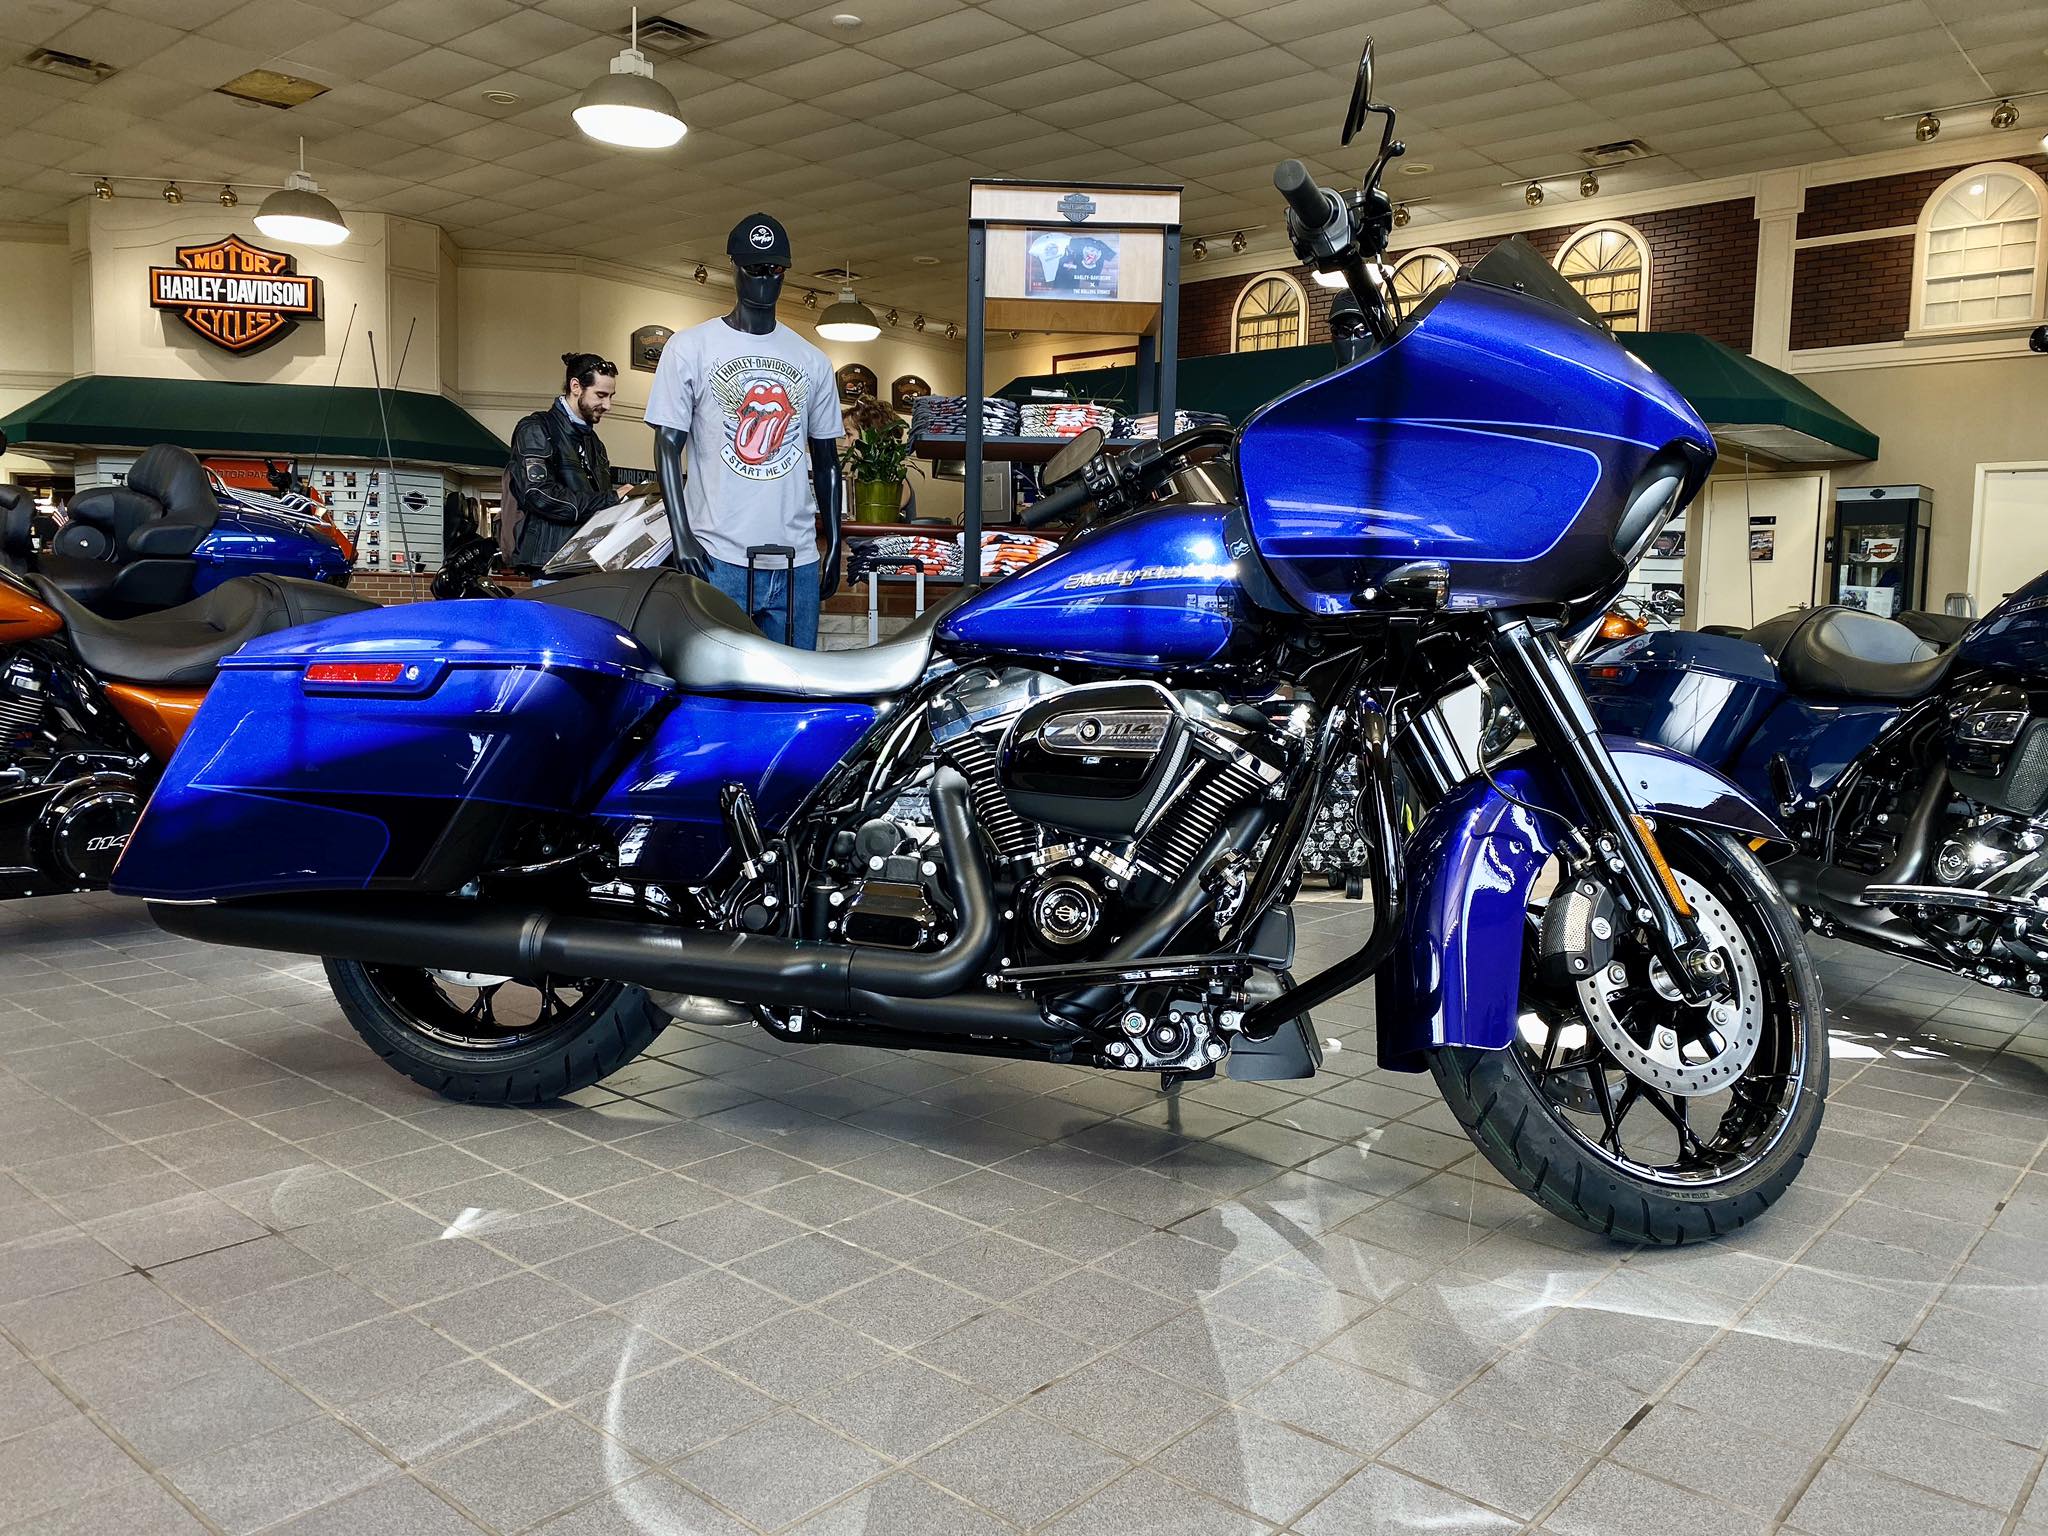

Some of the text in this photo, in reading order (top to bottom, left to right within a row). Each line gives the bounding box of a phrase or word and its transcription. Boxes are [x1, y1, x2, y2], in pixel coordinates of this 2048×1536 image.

[194, 245, 271, 273] MOTOR
[159, 275, 305, 306] HARLEY-DAVIDSON
[196, 309, 271, 343] CYCLES
[721, 358, 799, 380] HARLEY-DAVIDSON
[215, 469, 245, 479] OTOR
[729, 455, 792, 477] START ME UP
[1111, 723, 1153, 735] 114
